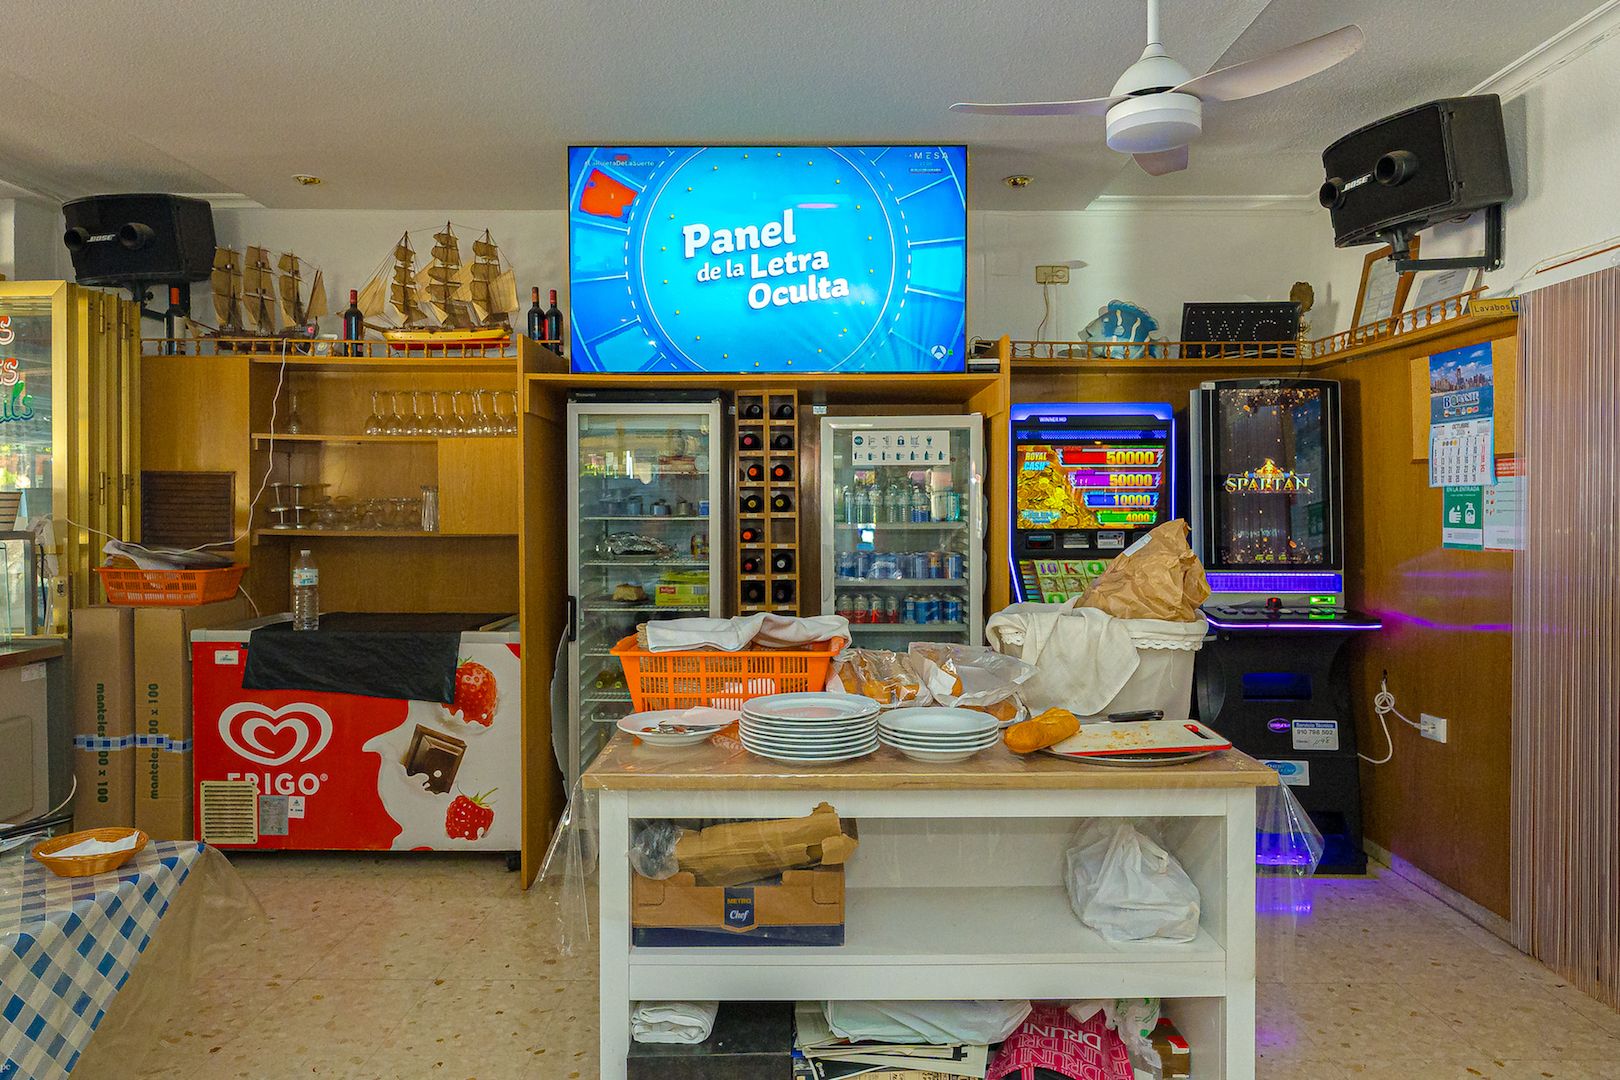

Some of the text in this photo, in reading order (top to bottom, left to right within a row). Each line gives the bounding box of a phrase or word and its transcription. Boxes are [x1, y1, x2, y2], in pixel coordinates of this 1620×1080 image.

[1341, 174, 1372, 193] BOSE
[683, 208, 797, 259] Panel
[696, 250, 830, 283] de la Letra
[747, 274, 850, 310] Oculta
[1024, 451, 1047, 461] ROYAL
[1106, 451, 1155, 465] 50000
[1109, 474, 1153, 486] 50000
[1225, 477, 1312, 493] SPARTAN
[1113, 494, 1151, 506] 10000
[1125, 513, 1150, 522] 4000
[148, 683, 159, 704] 100
[96, 683, 108, 737] manteles
[148, 719, 159, 735] 00
[97, 750, 109, 766] 00
[149, 748, 160, 800] manteles
[97, 781, 109, 803] 100
[729, 909, 750, 921] Chef
[1023, 1022, 1101, 1051] DRUNI
